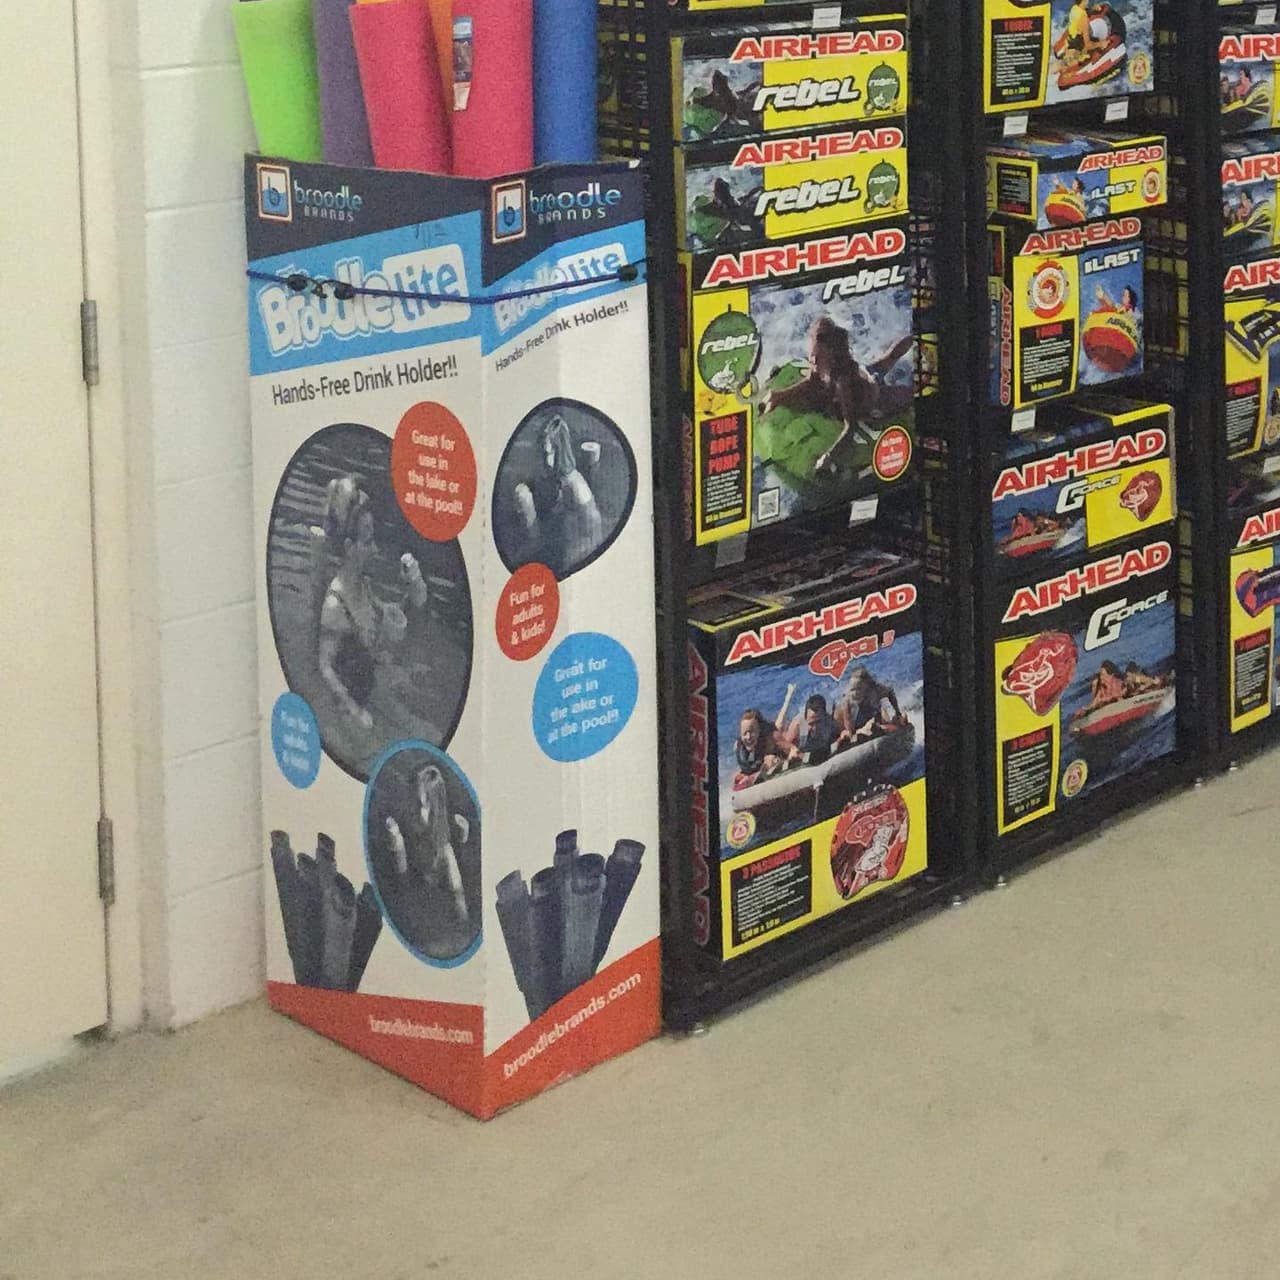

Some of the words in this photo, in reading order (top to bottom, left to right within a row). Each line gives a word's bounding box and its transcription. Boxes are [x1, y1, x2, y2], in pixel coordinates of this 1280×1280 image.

[729, 30, 905, 65] AIRHEAD
[729, 126, 904, 170] AIRHEAD
[1077, 145, 1165, 174] AIRHEAD
[294, 180, 363, 211] broodle
[529, 182, 622, 211] broodle
[1019, 217, 1142, 256] AIRHEAD
[701, 228, 907, 289] AIRHEAD
[272, 372, 351, 406] Hands-Free
[353, 366, 395, 397] Drink
[397, 354, 459, 384] Holder!!
[411, 429, 440, 450] Great
[441, 437, 457, 452] for
[407, 470, 425, 486] the
[992, 427, 1168, 501] AIRHEAD
[510, 590, 528, 607] Fun
[529, 584, 545, 598] for
[1000, 540, 1173, 624] AIRHEAD
[724, 583, 918, 667] AIRHEAD
[587, 656, 609, 672] for
[561, 684, 581, 699] use
[584, 678, 598, 693] in
